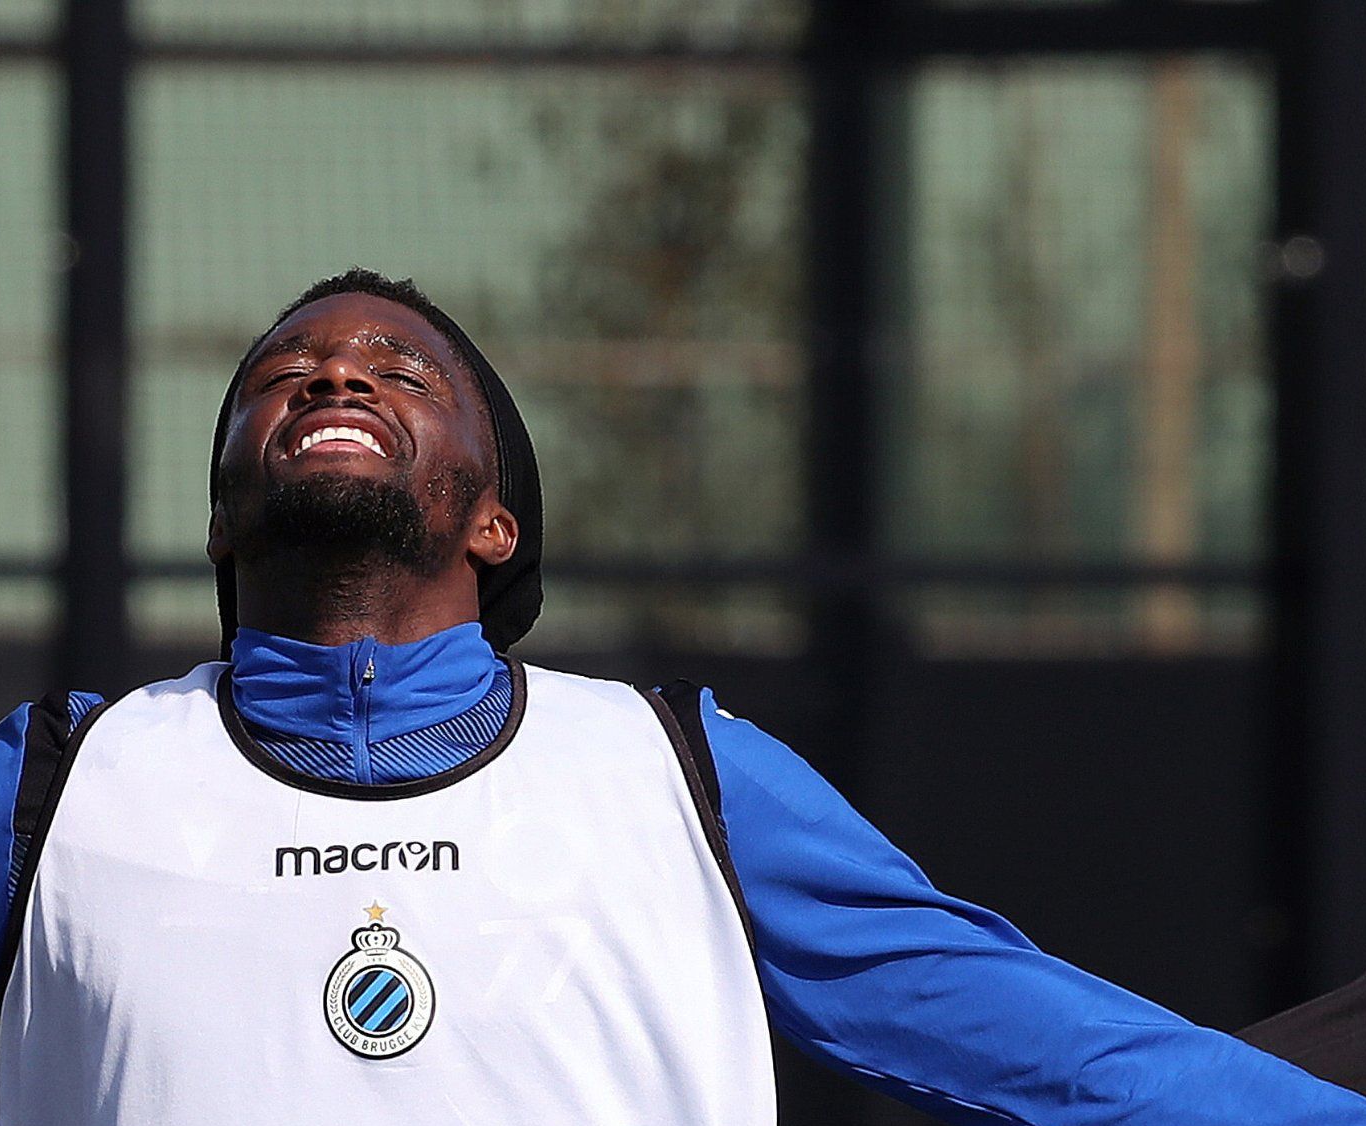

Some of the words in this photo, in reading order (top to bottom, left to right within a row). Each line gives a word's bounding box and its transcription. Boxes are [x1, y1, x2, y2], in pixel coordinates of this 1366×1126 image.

[276, 841, 459, 876] macron
[333, 1016, 359, 1045] CLUB
[361, 1031, 413, 1052] BRUGGE
